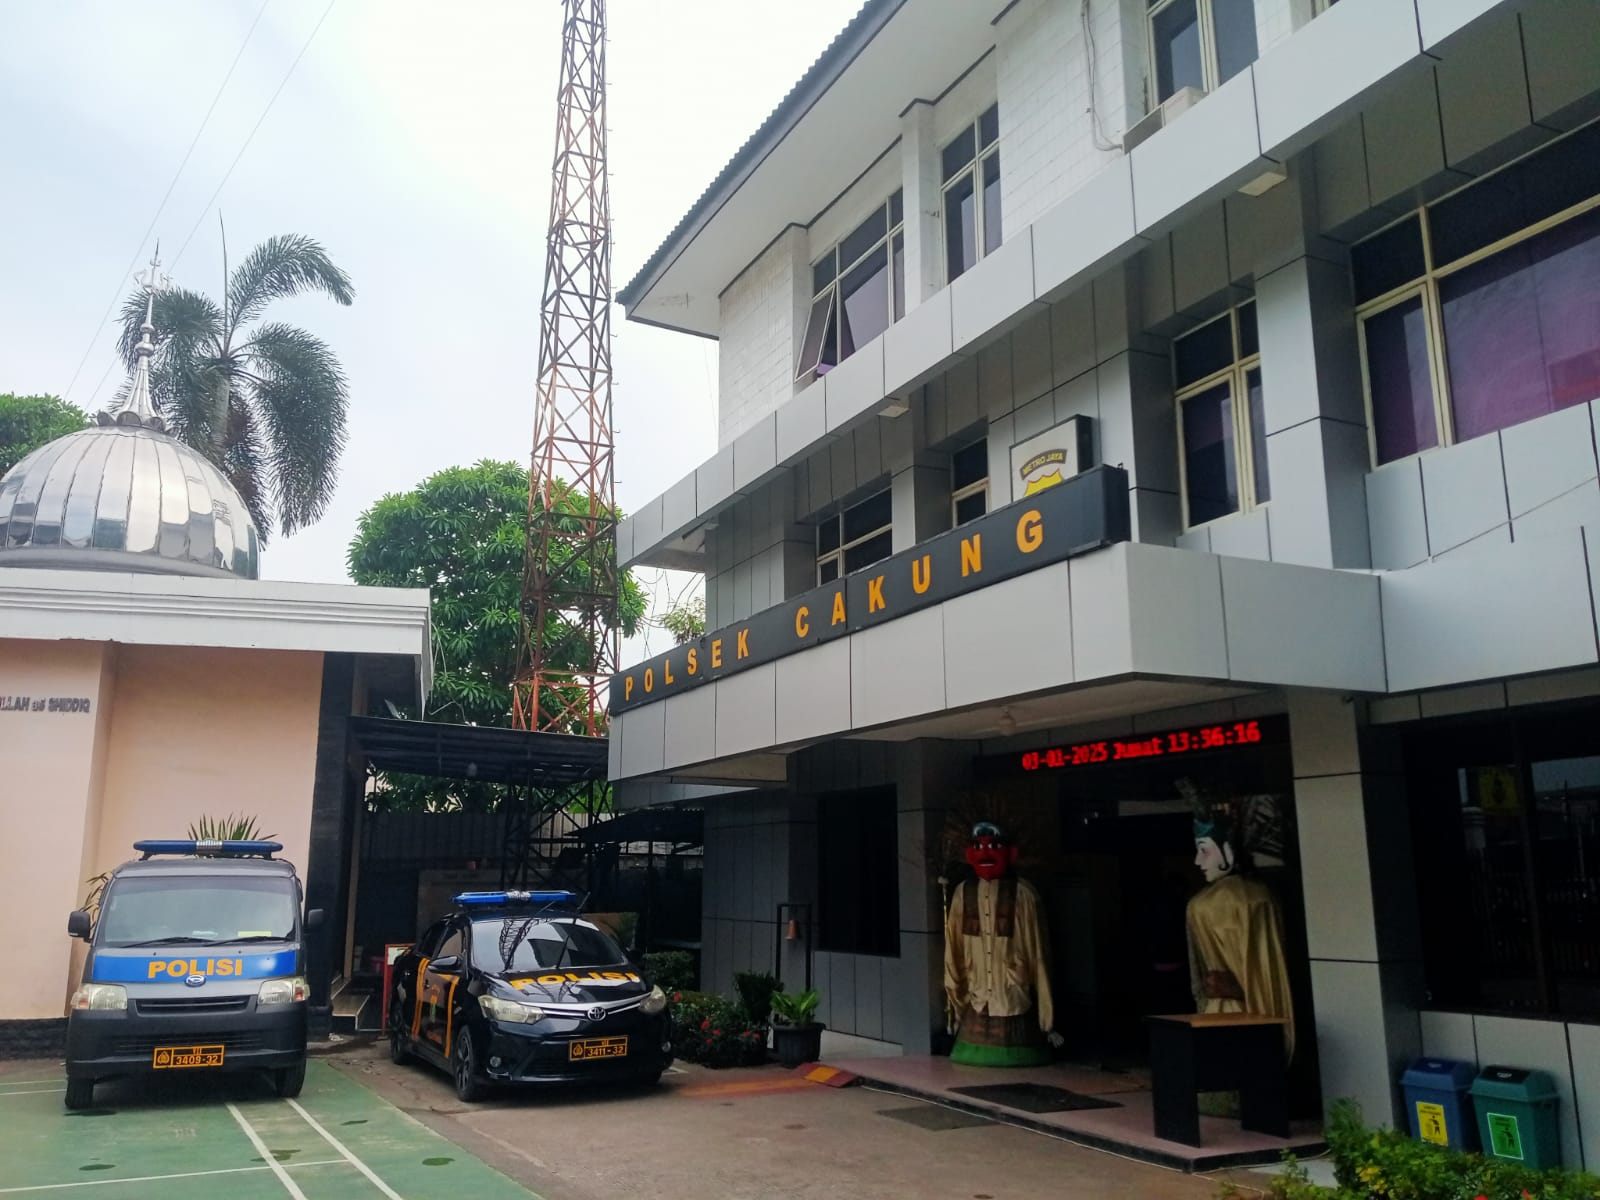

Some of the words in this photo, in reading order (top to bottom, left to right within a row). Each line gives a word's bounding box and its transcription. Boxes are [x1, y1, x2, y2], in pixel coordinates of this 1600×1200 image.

[1022, 455, 1046, 476] METRO
[1046, 452, 1063, 462] JAYA
[625, 628, 750, 701] POLSEK
[795, 509, 1044, 638] CAKUNG
[1022, 742, 1108, 770] 03-01-2025
[1113, 737, 1163, 760] Jumat
[1168, 721, 1262, 752] 13:36:16
[147, 958, 243, 979] POLISI
[509, 972, 641, 991] POLISI
